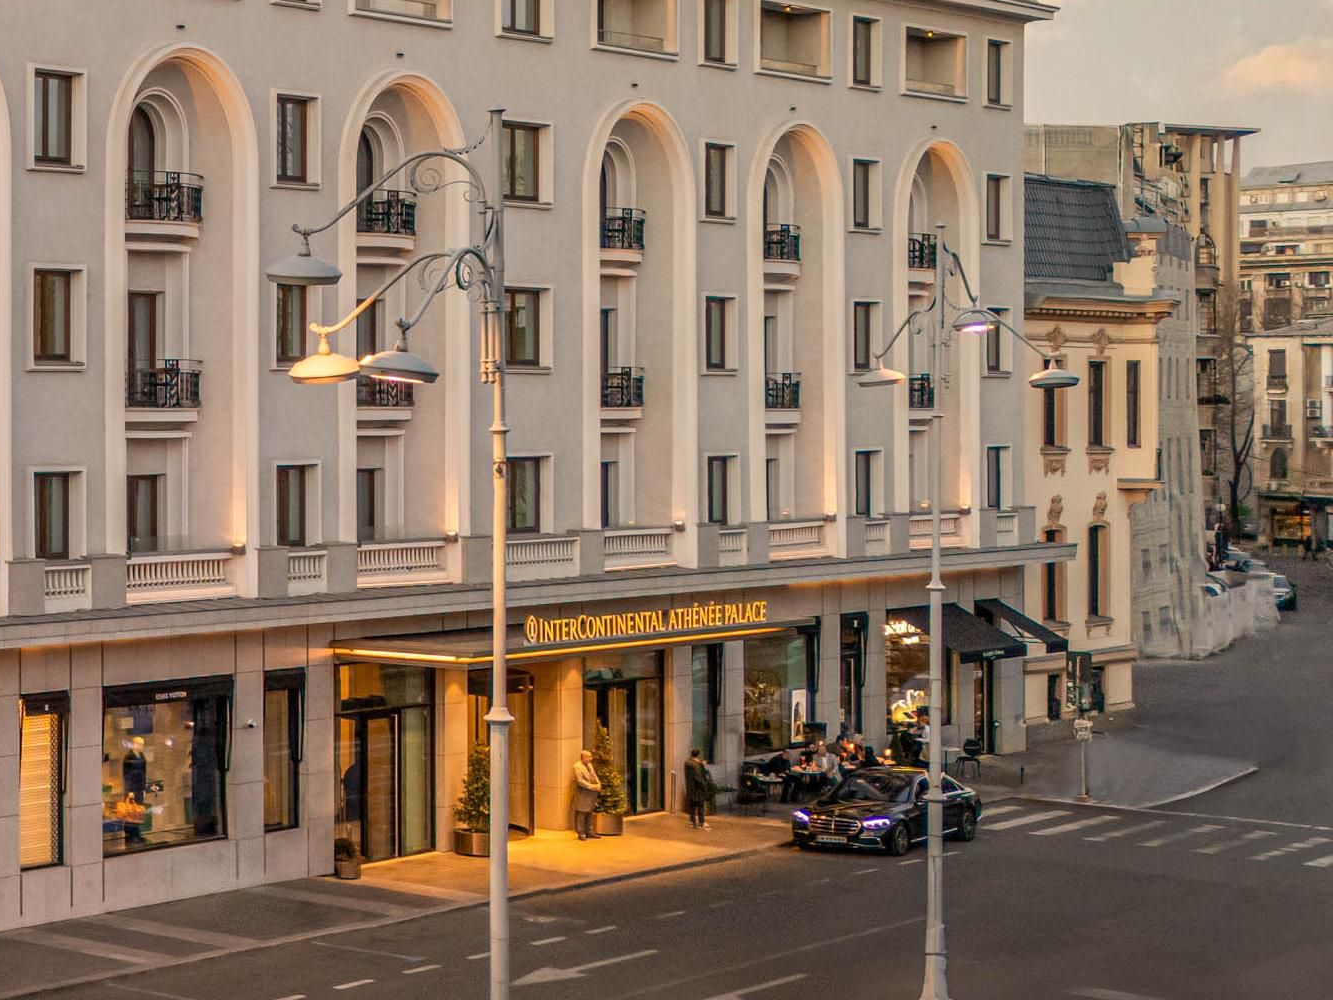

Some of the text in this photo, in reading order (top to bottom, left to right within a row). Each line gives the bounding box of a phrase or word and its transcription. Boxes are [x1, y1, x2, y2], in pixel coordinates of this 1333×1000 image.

[538, 610, 666, 643] INTERCONTINENTAL
[668, 601, 723, 631] ATHÉNÉE
[724, 601, 767, 623] PALACE
